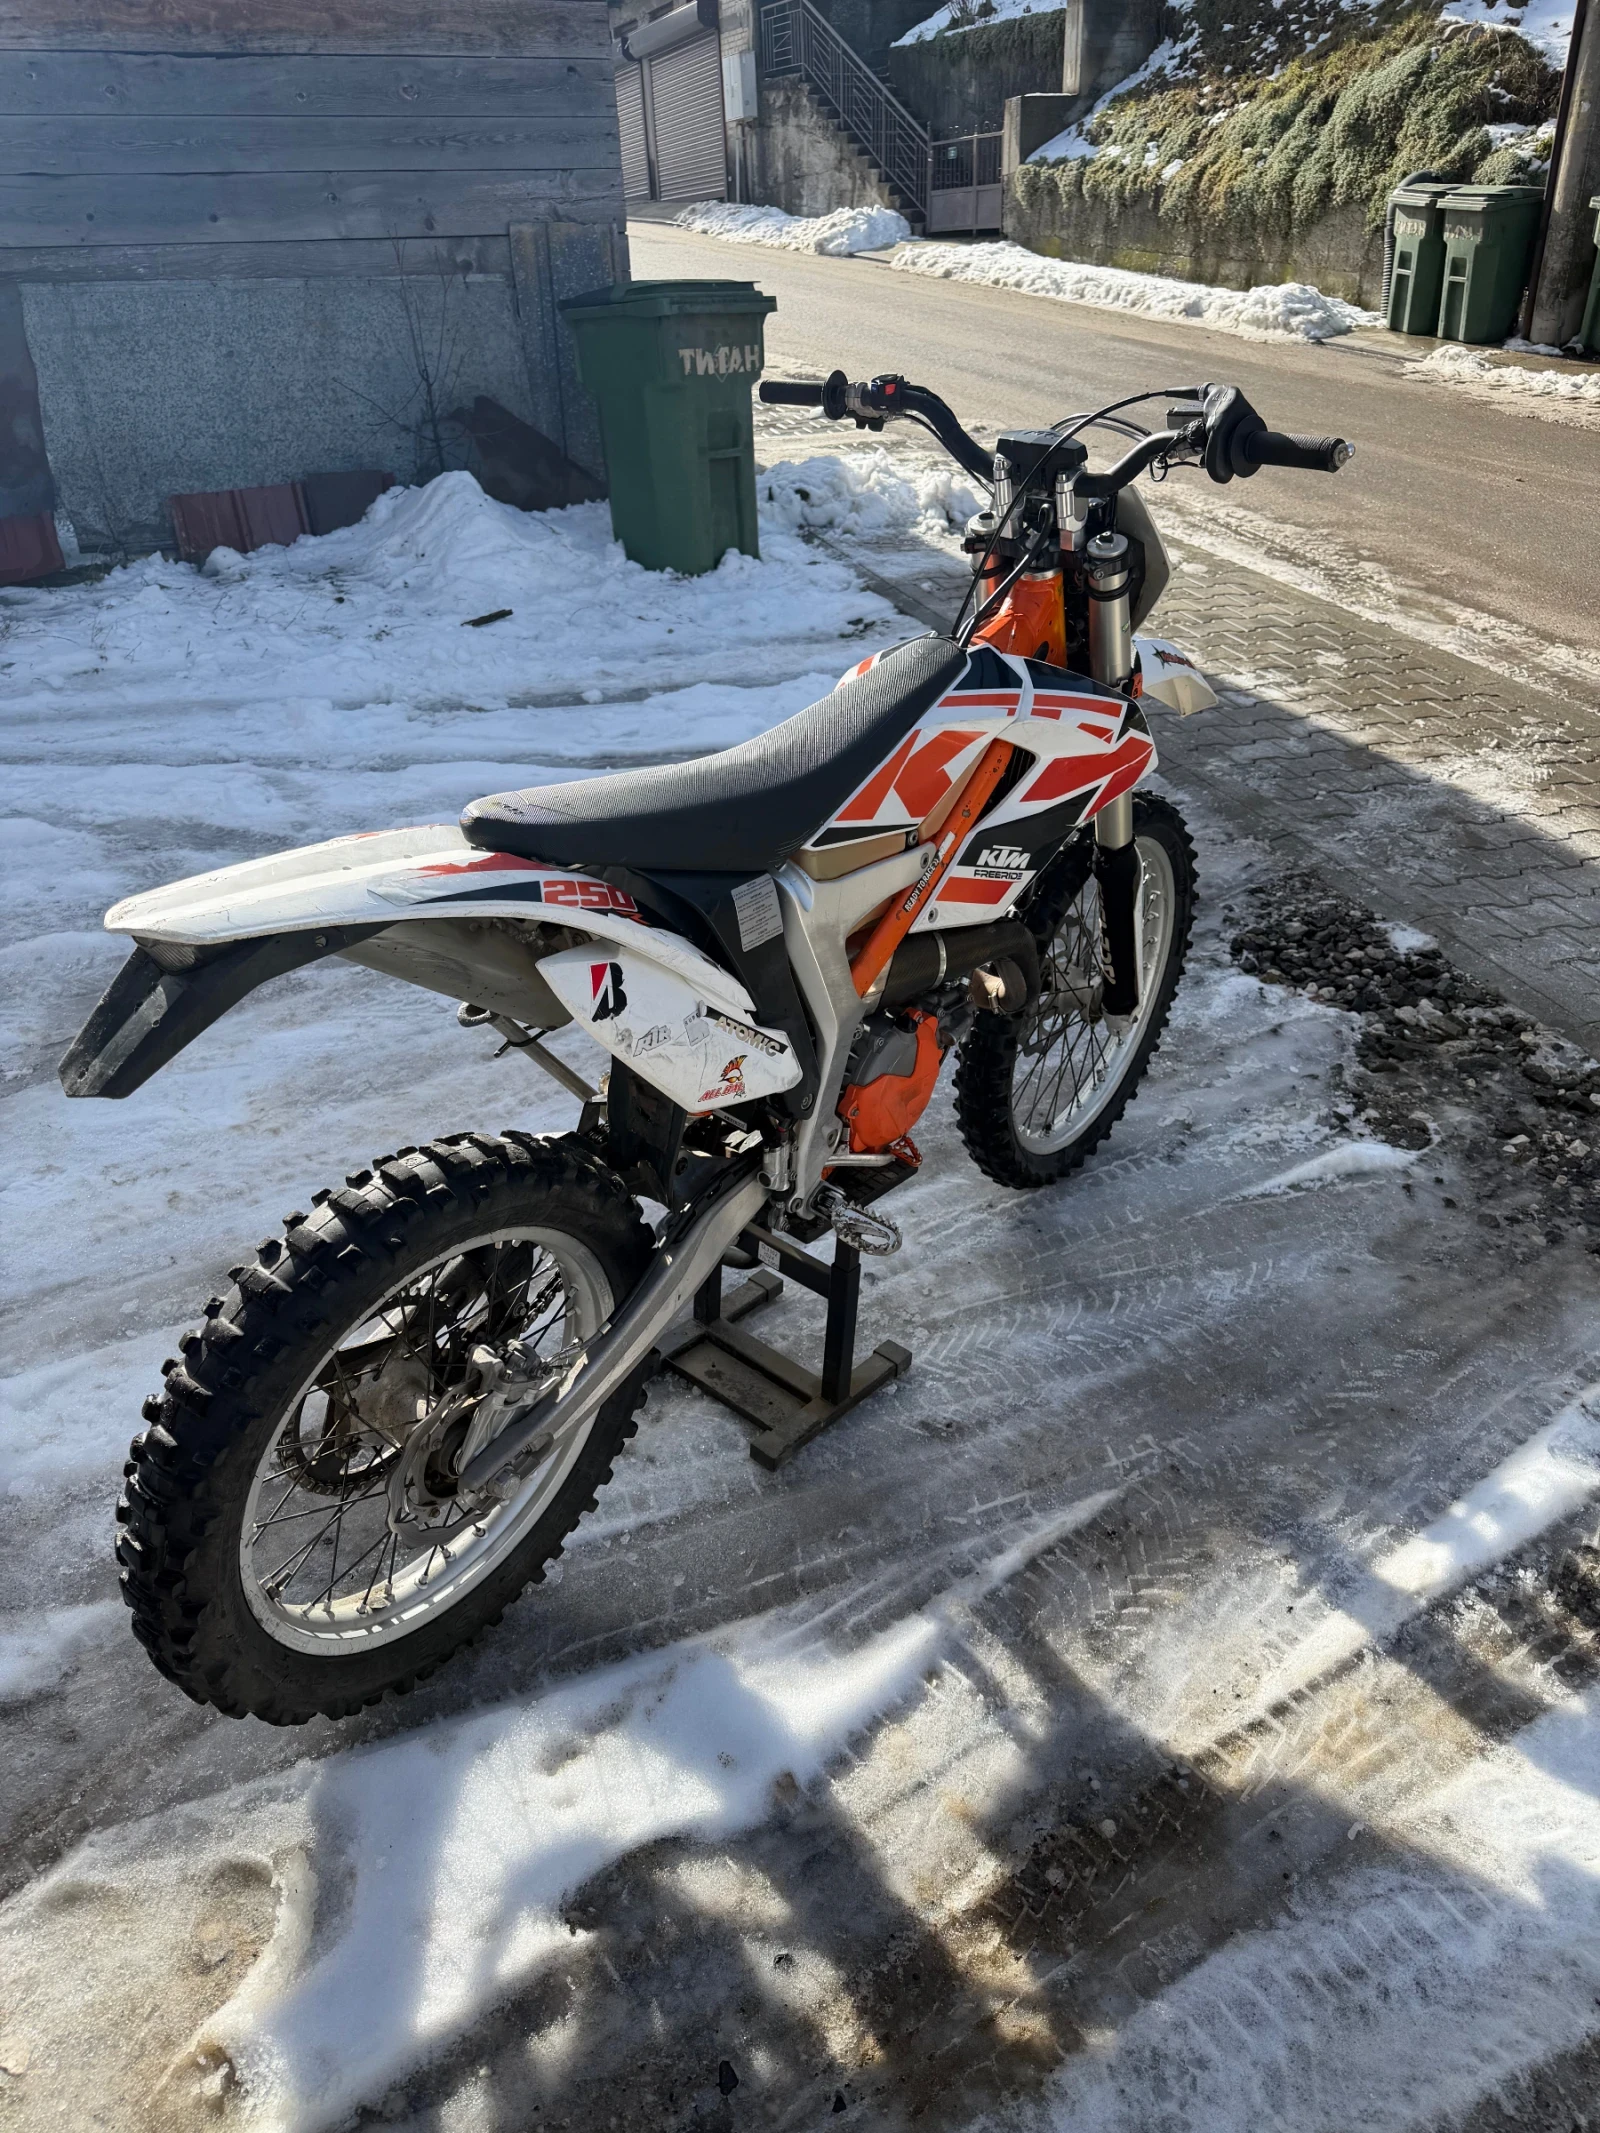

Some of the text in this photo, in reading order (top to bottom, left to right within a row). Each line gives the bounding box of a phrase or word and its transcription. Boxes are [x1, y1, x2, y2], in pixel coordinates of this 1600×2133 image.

[976, 845, 1031, 869] KTM
[904, 864, 936, 912] READY TO RACE
[973, 869, 1023, 880] FREERIDE
[543, 880, 637, 912] 250
[714, 1015, 780, 1057] ATOMIC
